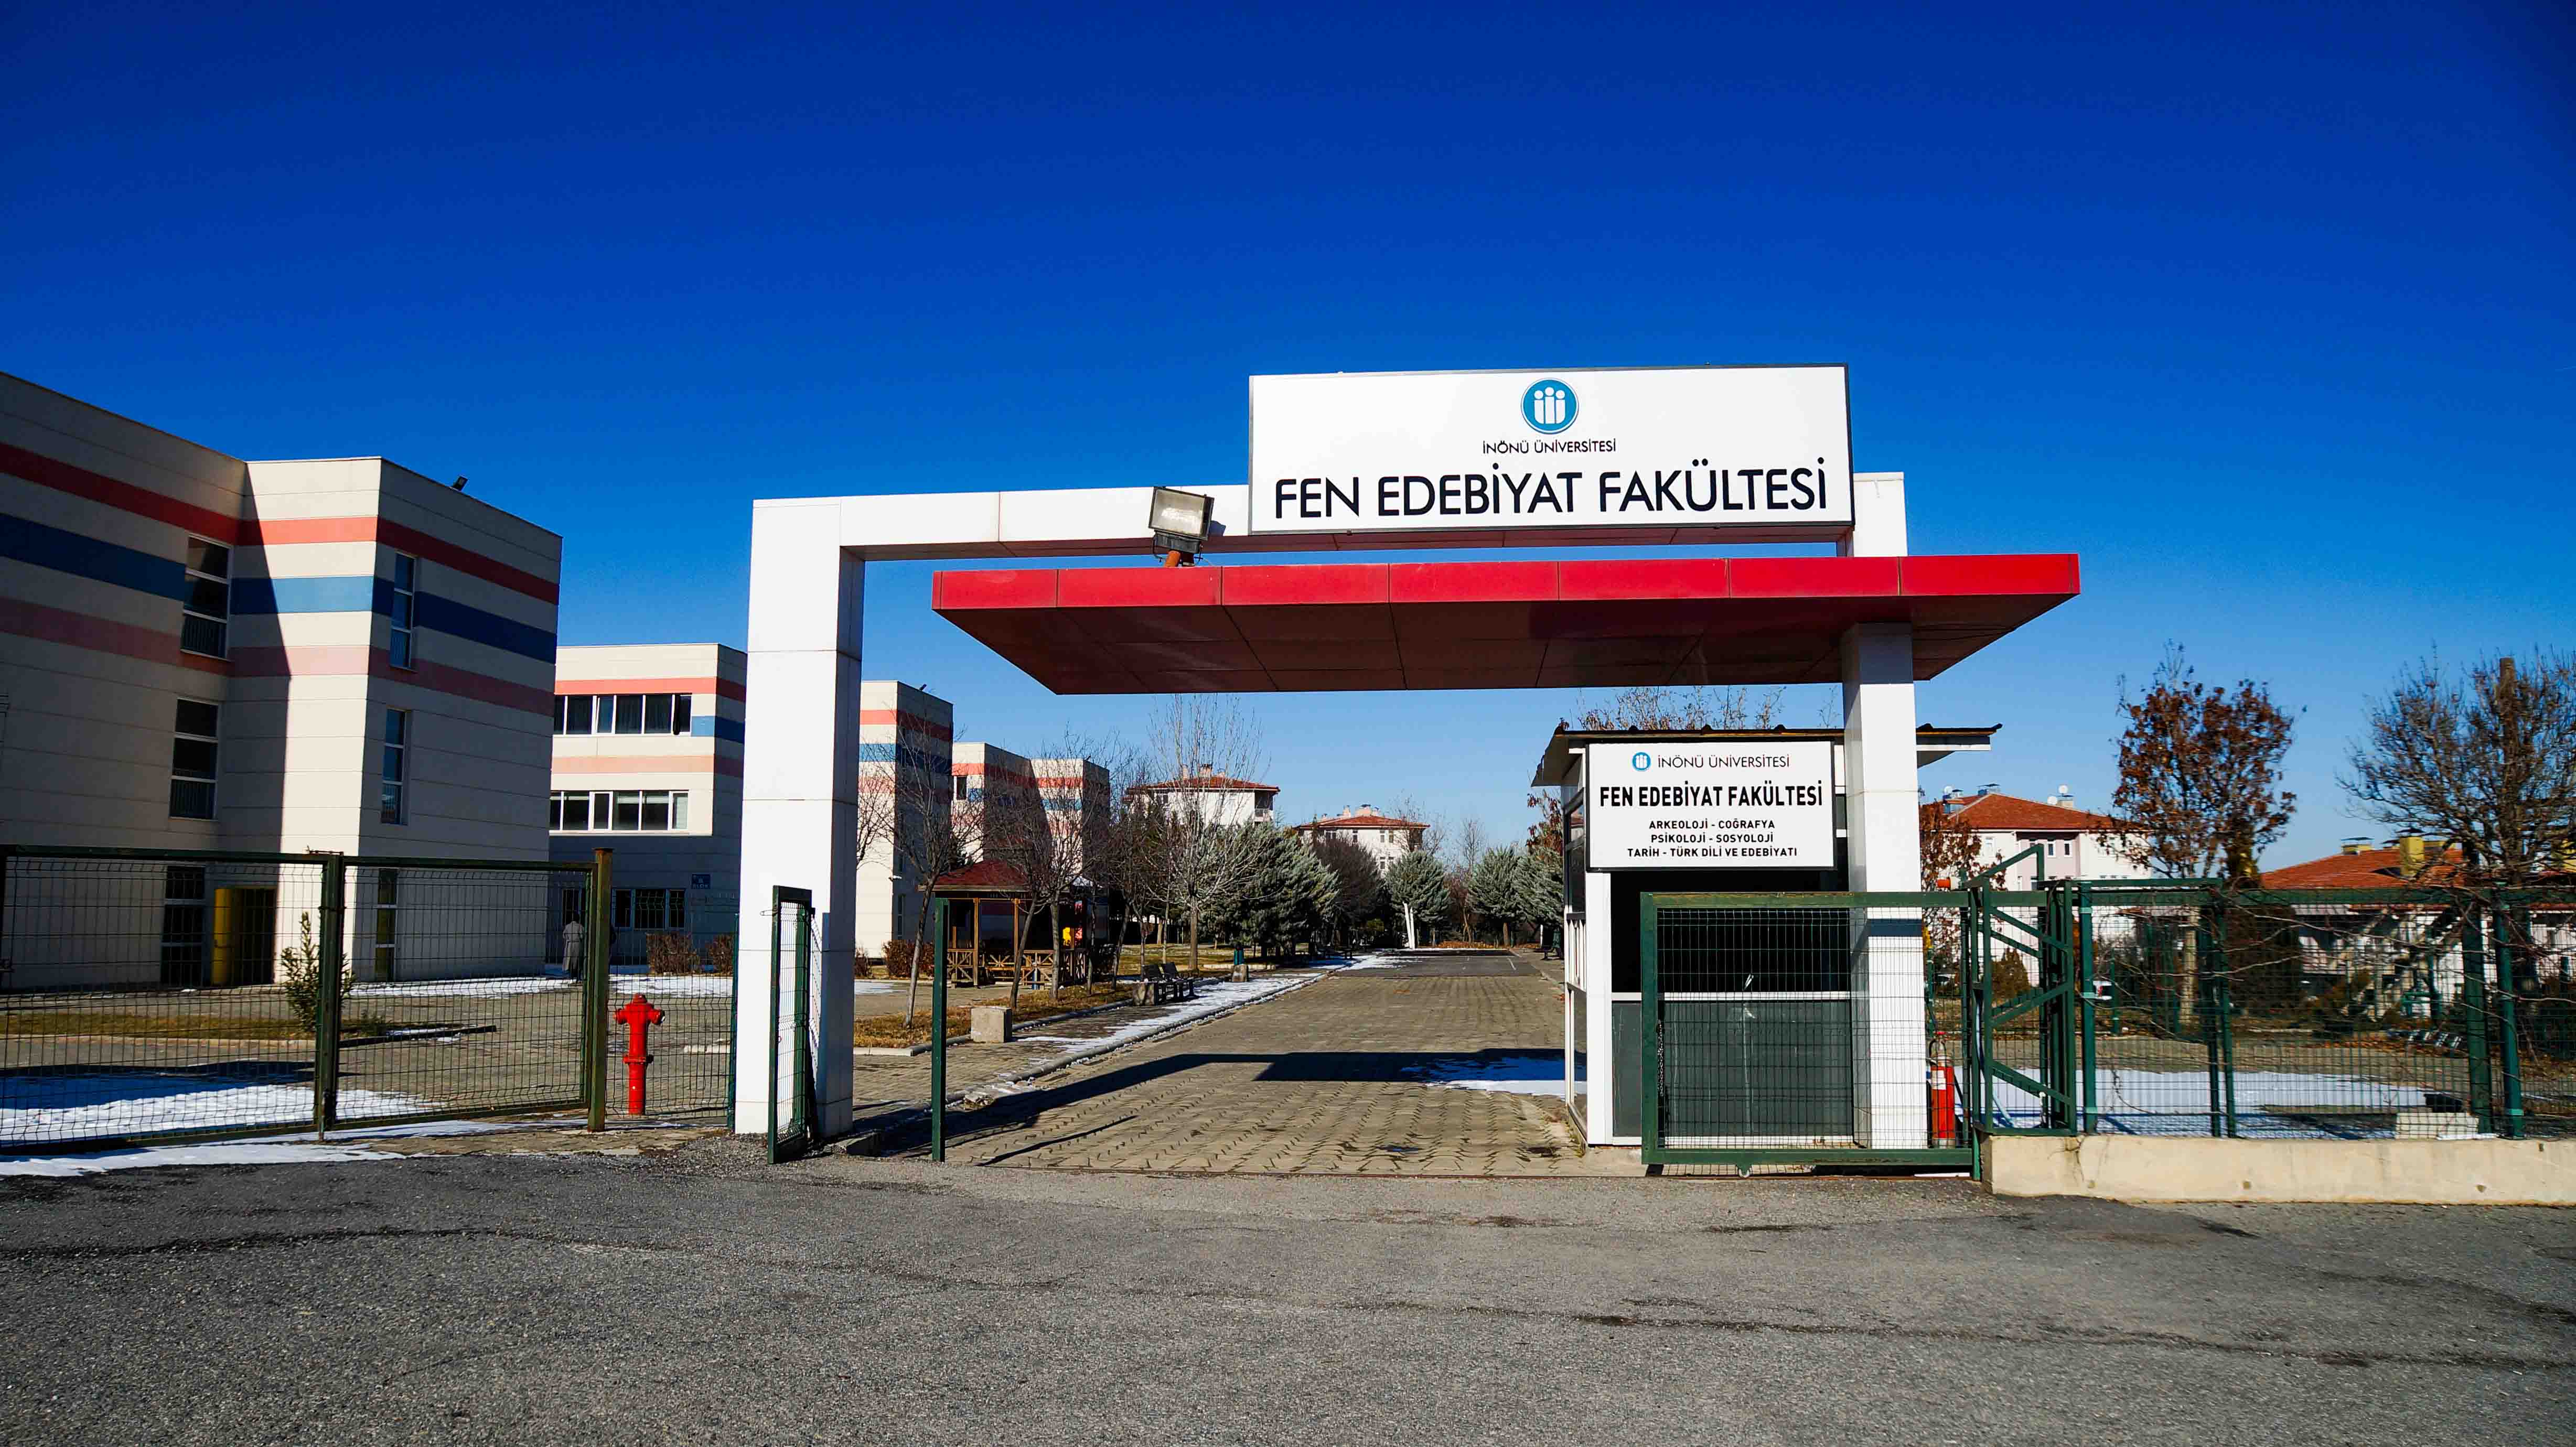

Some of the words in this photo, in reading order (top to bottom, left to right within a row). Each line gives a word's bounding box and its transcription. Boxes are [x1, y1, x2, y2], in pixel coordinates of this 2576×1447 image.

[1483, 440, 1529, 454] İNÖNÜ
[1534, 438, 1616, 453] ÜNİVERSİTESİ
[1275, 477, 1359, 519] FEN
[1378, 462, 1583, 516] EDEBİYAT
[1599, 457, 1827, 512] FAKÜLTESİ
[1658, 754, 1704, 768] İNÖNÜ
[1709, 754, 1789, 768] ÜNİVERSİTESİ
[1600, 786, 1633, 807] FEN
[1639, 780, 1723, 807] EDEBİYAT
[1728, 780, 1822, 806] FAKÜLTESİ
[1649, 818, 1708, 829] ARKEOLOJİ
[1718, 818, 1775, 829] COĞRAFYA
[1651, 832, 1705, 843] PSİKOLOJİ
[1716, 832, 1773, 843] SOSYOLOJİ
[1627, 846, 1659, 857] TARİH
[1670, 846, 1699, 857] TÜRK
[1702, 846, 1722, 857] DİLİ
[1725, 848, 1738, 857] VE
[1741, 845, 1797, 857] EDEBİYATI
